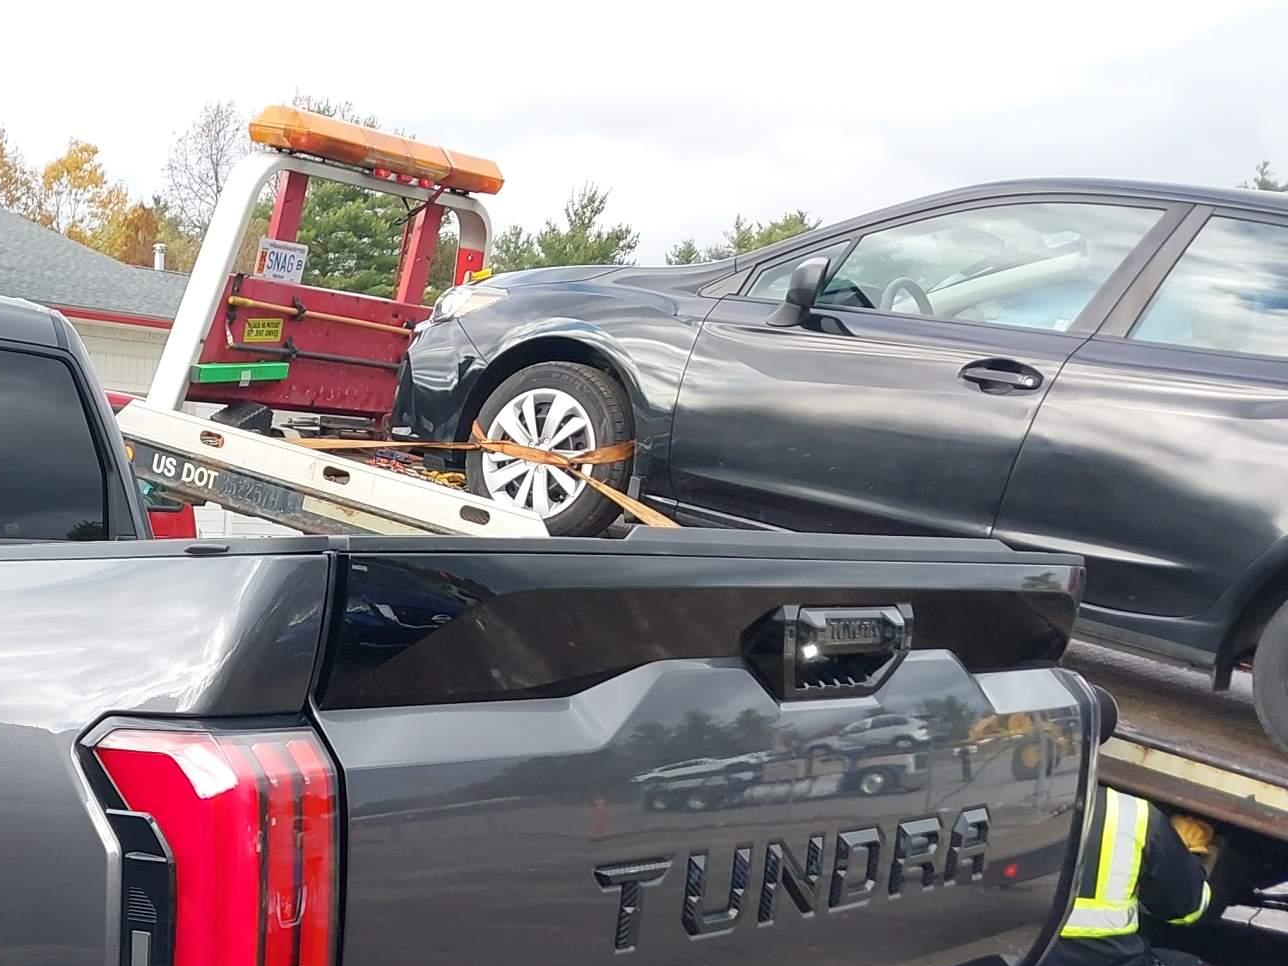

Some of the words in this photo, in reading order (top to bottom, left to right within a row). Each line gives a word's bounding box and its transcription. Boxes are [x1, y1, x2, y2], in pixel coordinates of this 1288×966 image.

[267, 251, 295, 273] SNAG
[296, 260, 303, 271] B
[152, 453, 177, 478] US
[181, 462, 219, 490] DOT
[829, 620, 880, 641] TOYOTA
[591, 803, 992, 955] TUNDRA
